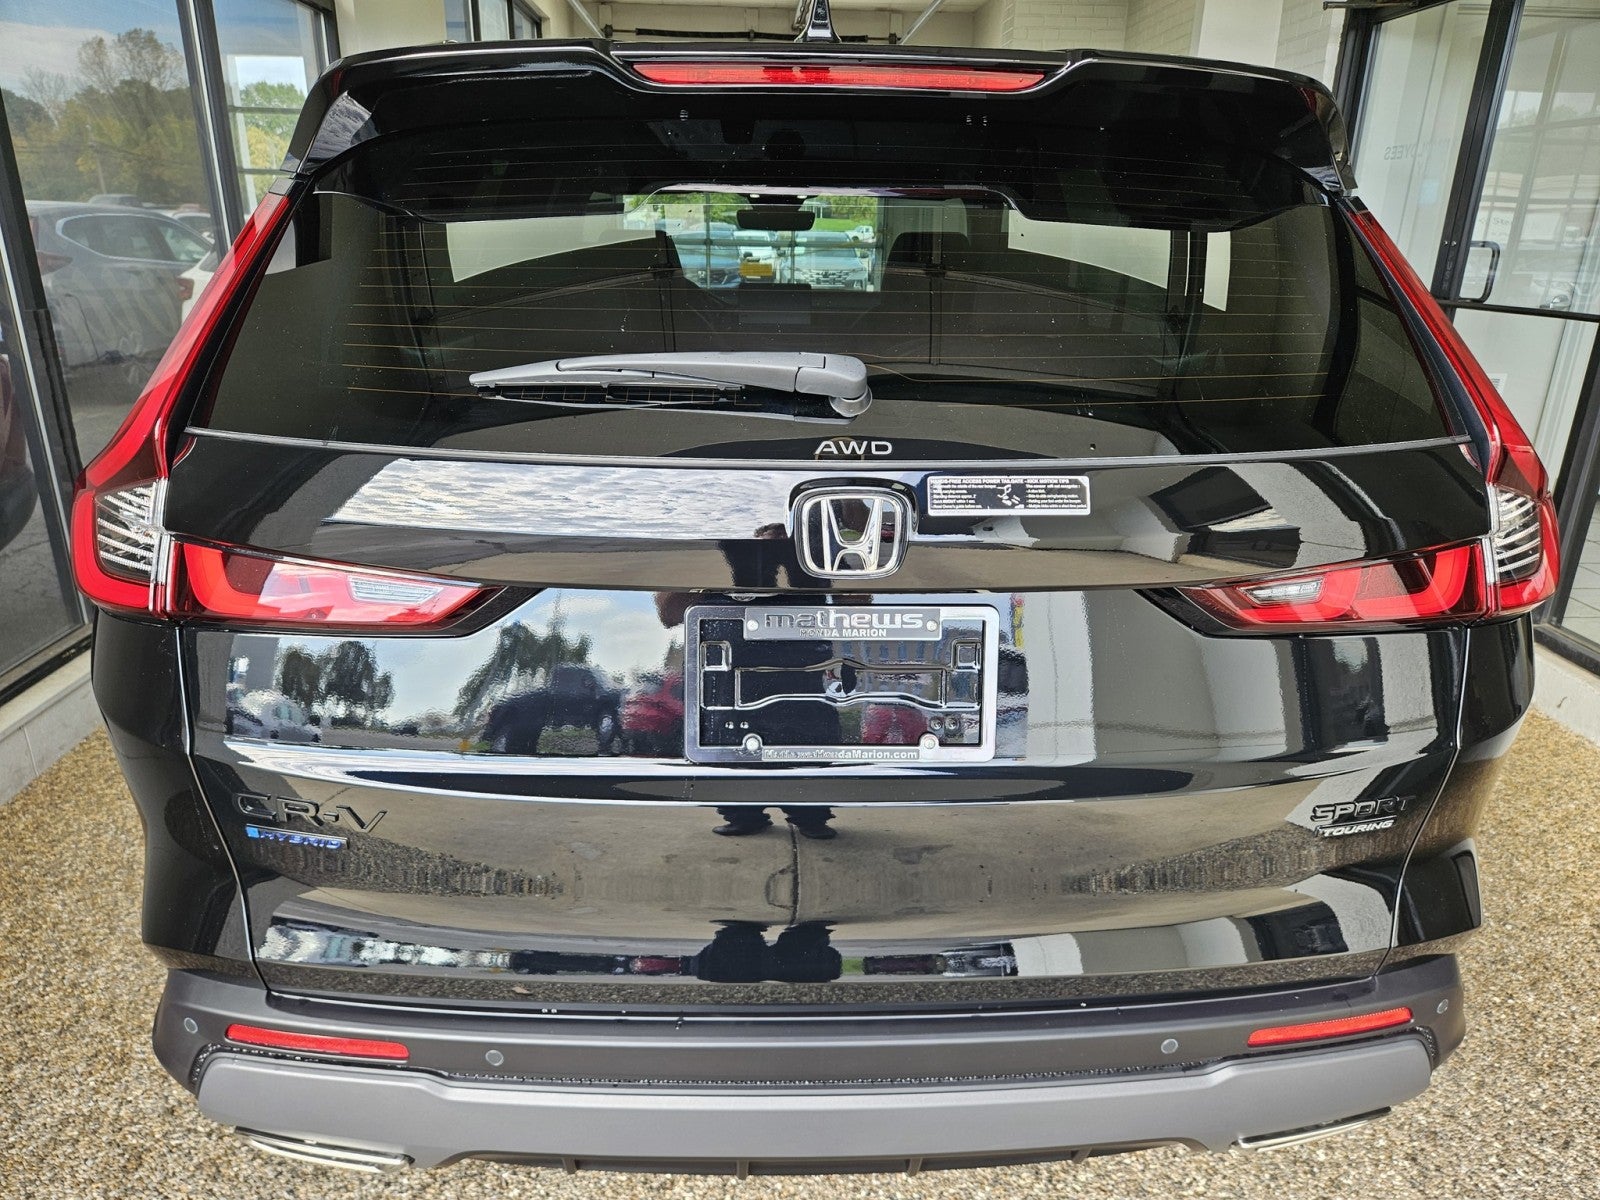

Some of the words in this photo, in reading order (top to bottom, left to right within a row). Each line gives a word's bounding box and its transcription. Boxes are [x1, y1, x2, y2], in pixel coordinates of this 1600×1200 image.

[814, 440, 893, 455] AWD
[765, 609, 923, 629] mathews
[800, 628, 839, 637] HONDA
[842, 628, 887, 637] MARION
[237, 793, 388, 833] CR-V
[1310, 796, 1416, 822] SPORT
[1320, 819, 1395, 837] TOURING
[260, 831, 343, 849] HYBRID
